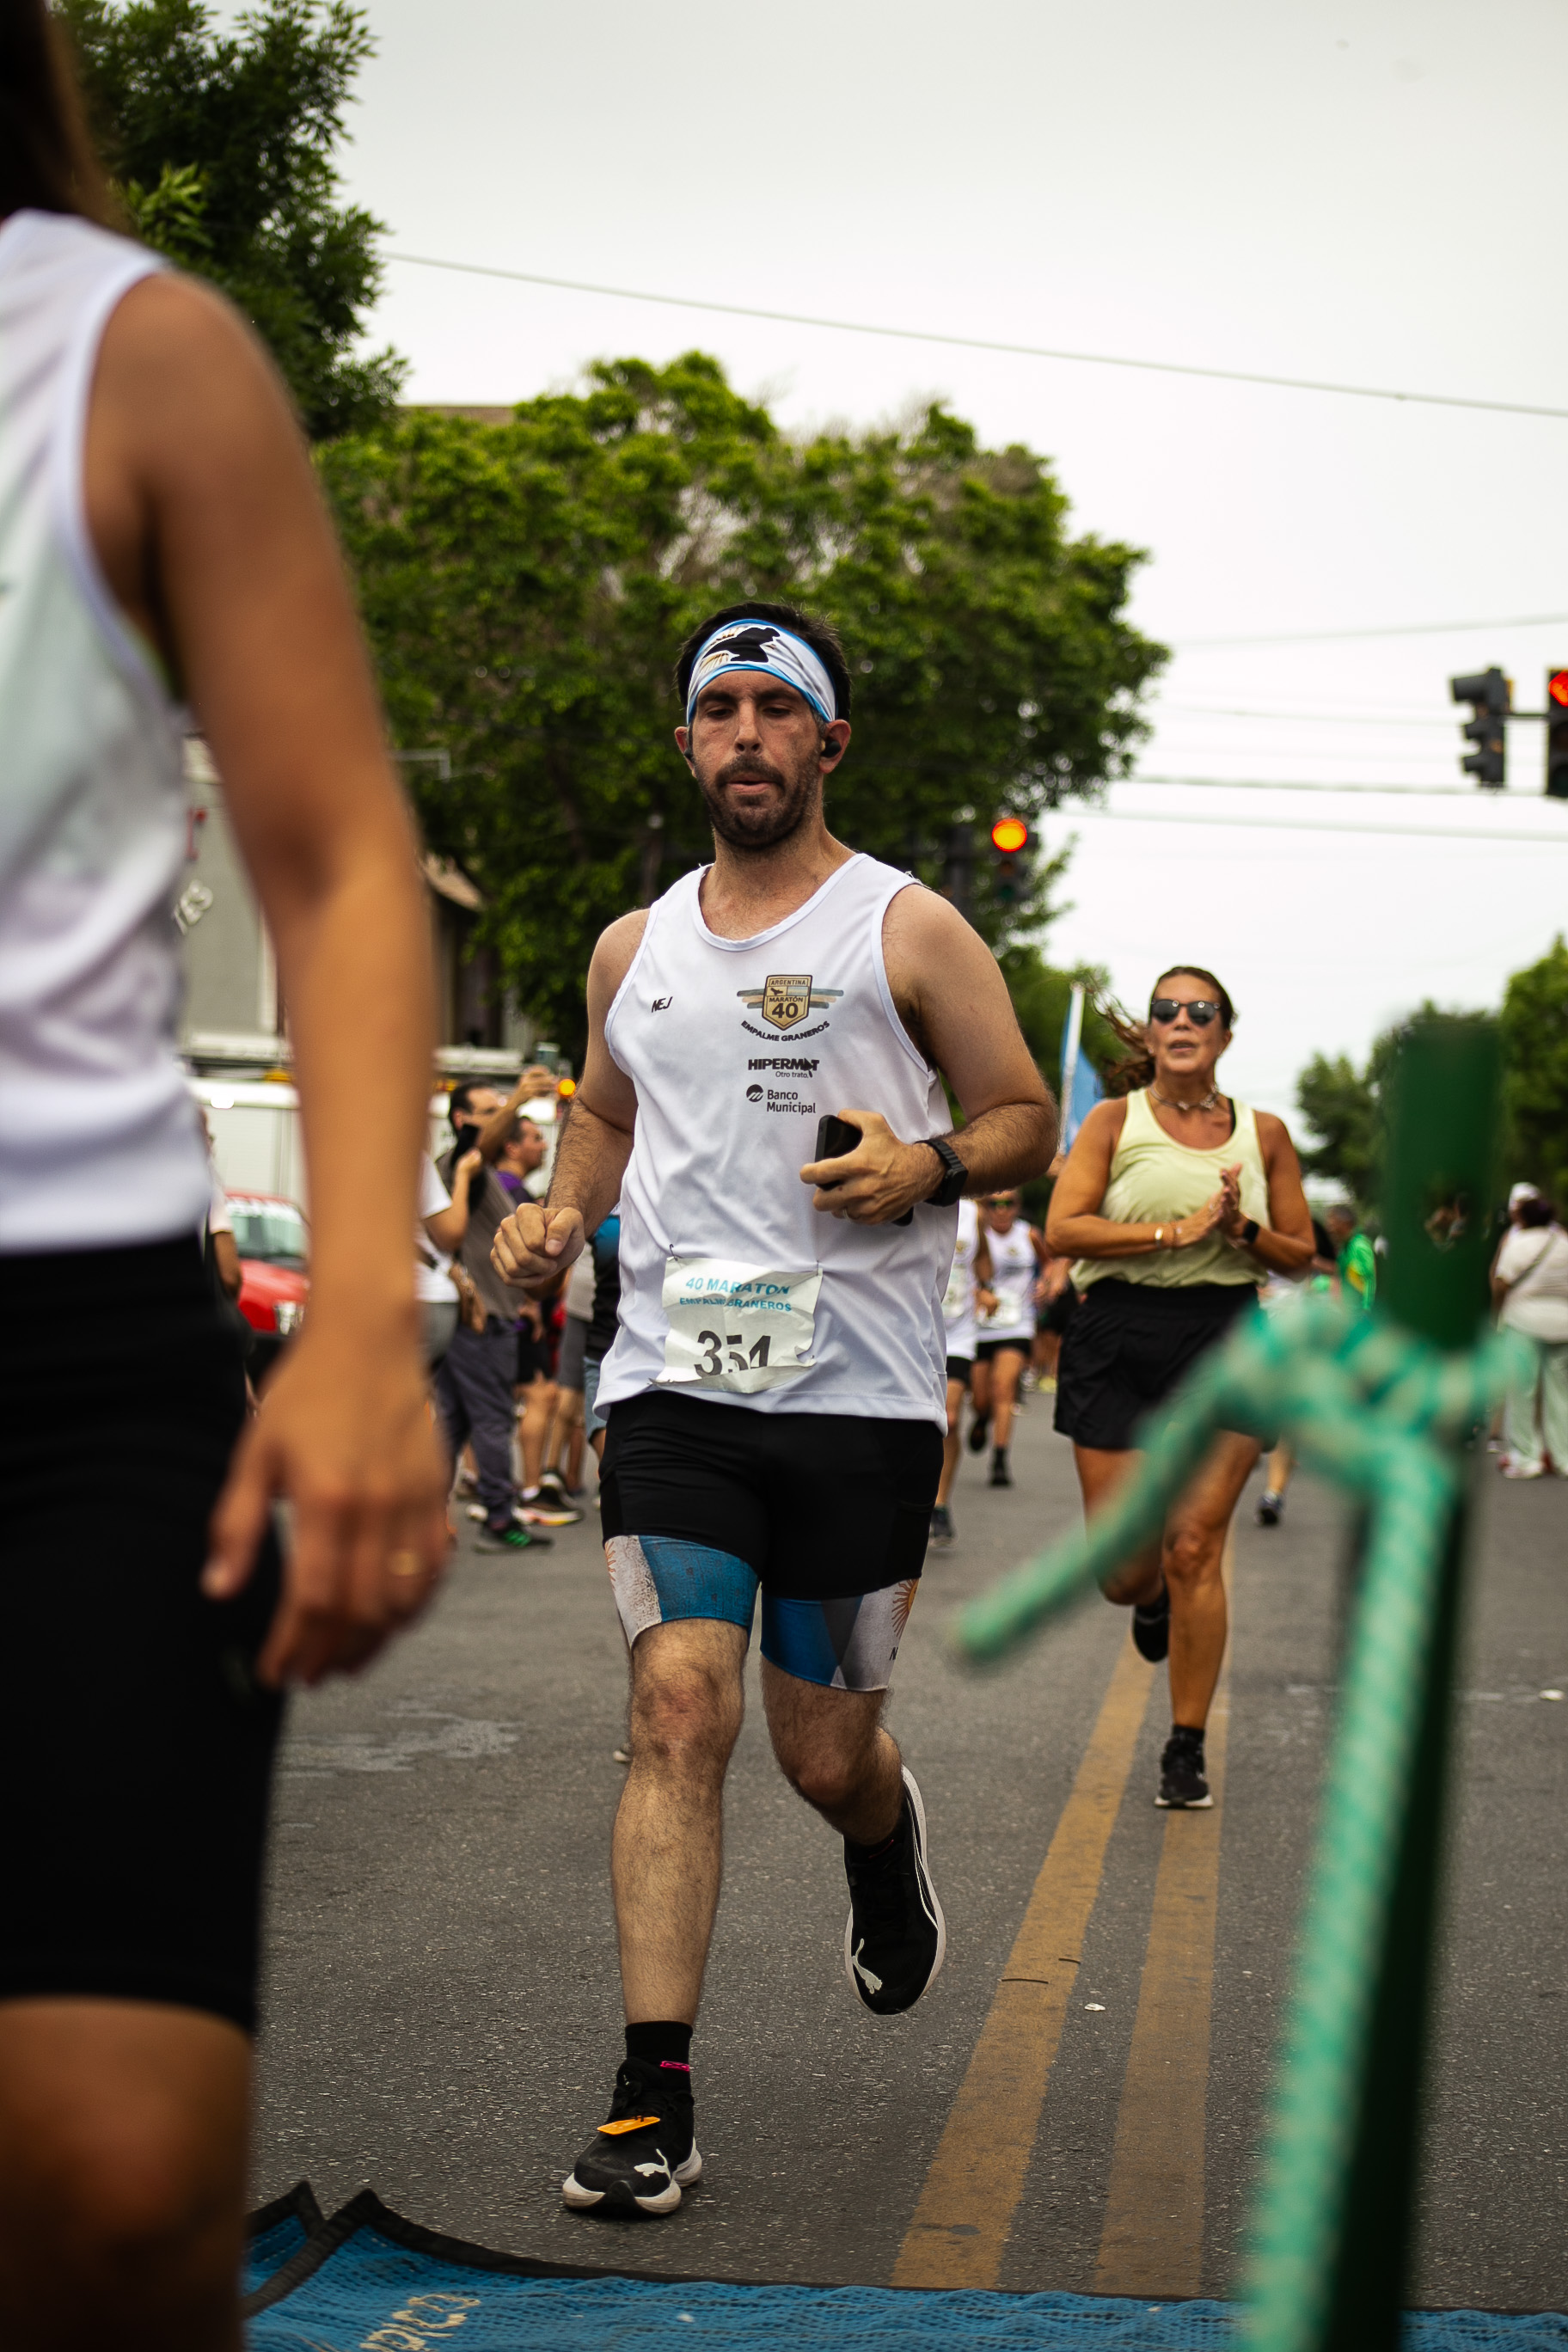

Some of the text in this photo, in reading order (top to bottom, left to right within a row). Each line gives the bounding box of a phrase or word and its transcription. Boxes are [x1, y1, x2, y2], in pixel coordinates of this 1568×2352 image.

[771, 1002, 799, 1019] 40
[741, 1020, 830, 1042] EMPALME GRANEROS
[767, 1089, 799, 1100] Banco
[767, 1101, 817, 1116] Municipal
[685, 1277, 704, 1290] 40
[694, 1330, 771, 1379] 354
